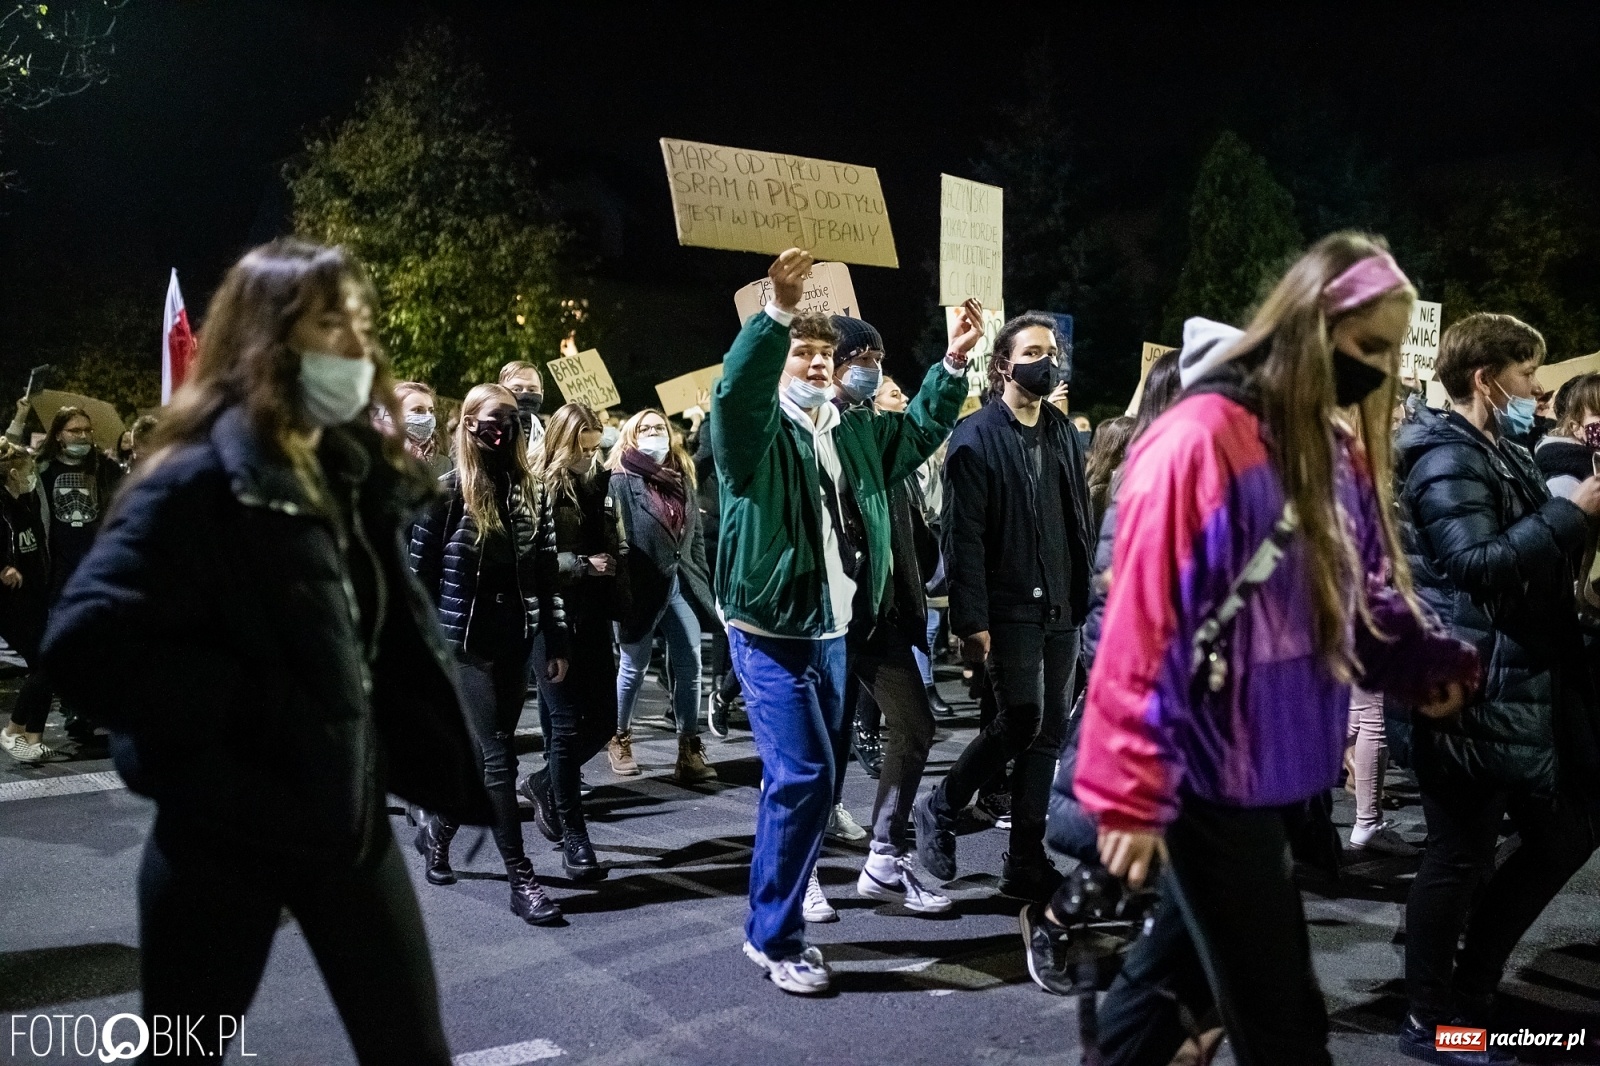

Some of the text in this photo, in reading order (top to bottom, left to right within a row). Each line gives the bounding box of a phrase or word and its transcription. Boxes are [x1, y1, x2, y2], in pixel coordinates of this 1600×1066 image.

[667, 143, 727, 173] MARS
[734, 152, 764, 175] OD
[827, 164, 859, 185] TO
[674, 171, 740, 201] SRAM
[747, 179, 759, 200] A
[764, 178, 808, 211] PIS
[679, 202, 723, 234] JEST
[1420, 306, 1435, 323] NIE
[550, 356, 586, 383] BABY
[1413, 353, 1435, 371] PRAWD
[565, 372, 600, 396] MAMY
